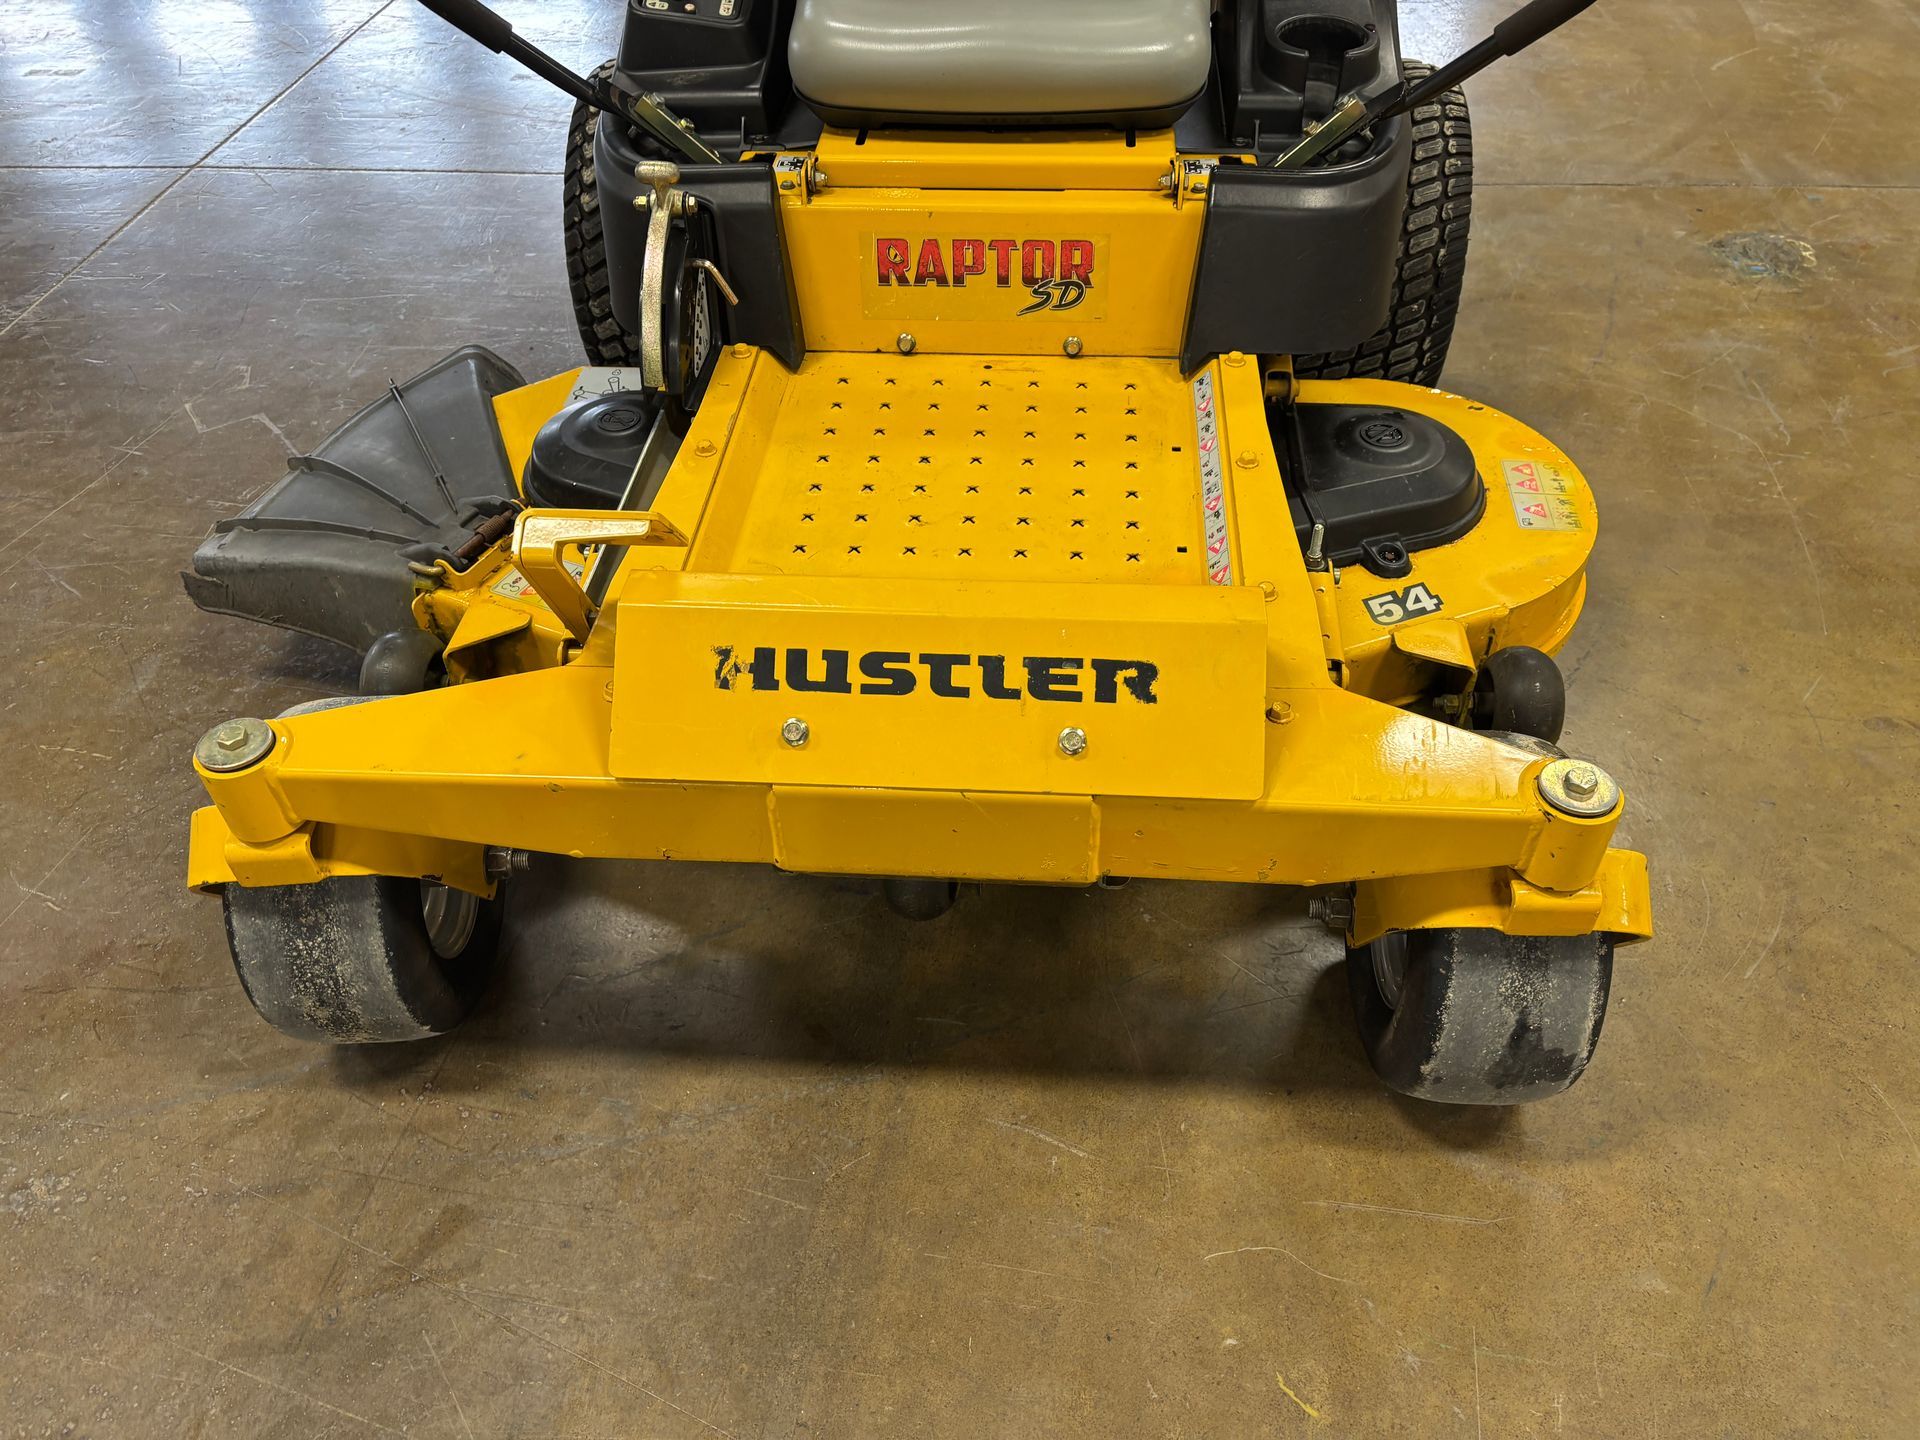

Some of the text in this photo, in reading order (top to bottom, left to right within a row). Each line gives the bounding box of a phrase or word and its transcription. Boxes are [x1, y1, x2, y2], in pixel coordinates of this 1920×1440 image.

[876, 238, 1094, 288] RAPTOR
[1016, 278, 1087, 316] SD
[1366, 585, 1440, 624] 54
[711, 645, 1159, 704] HUSTLER
